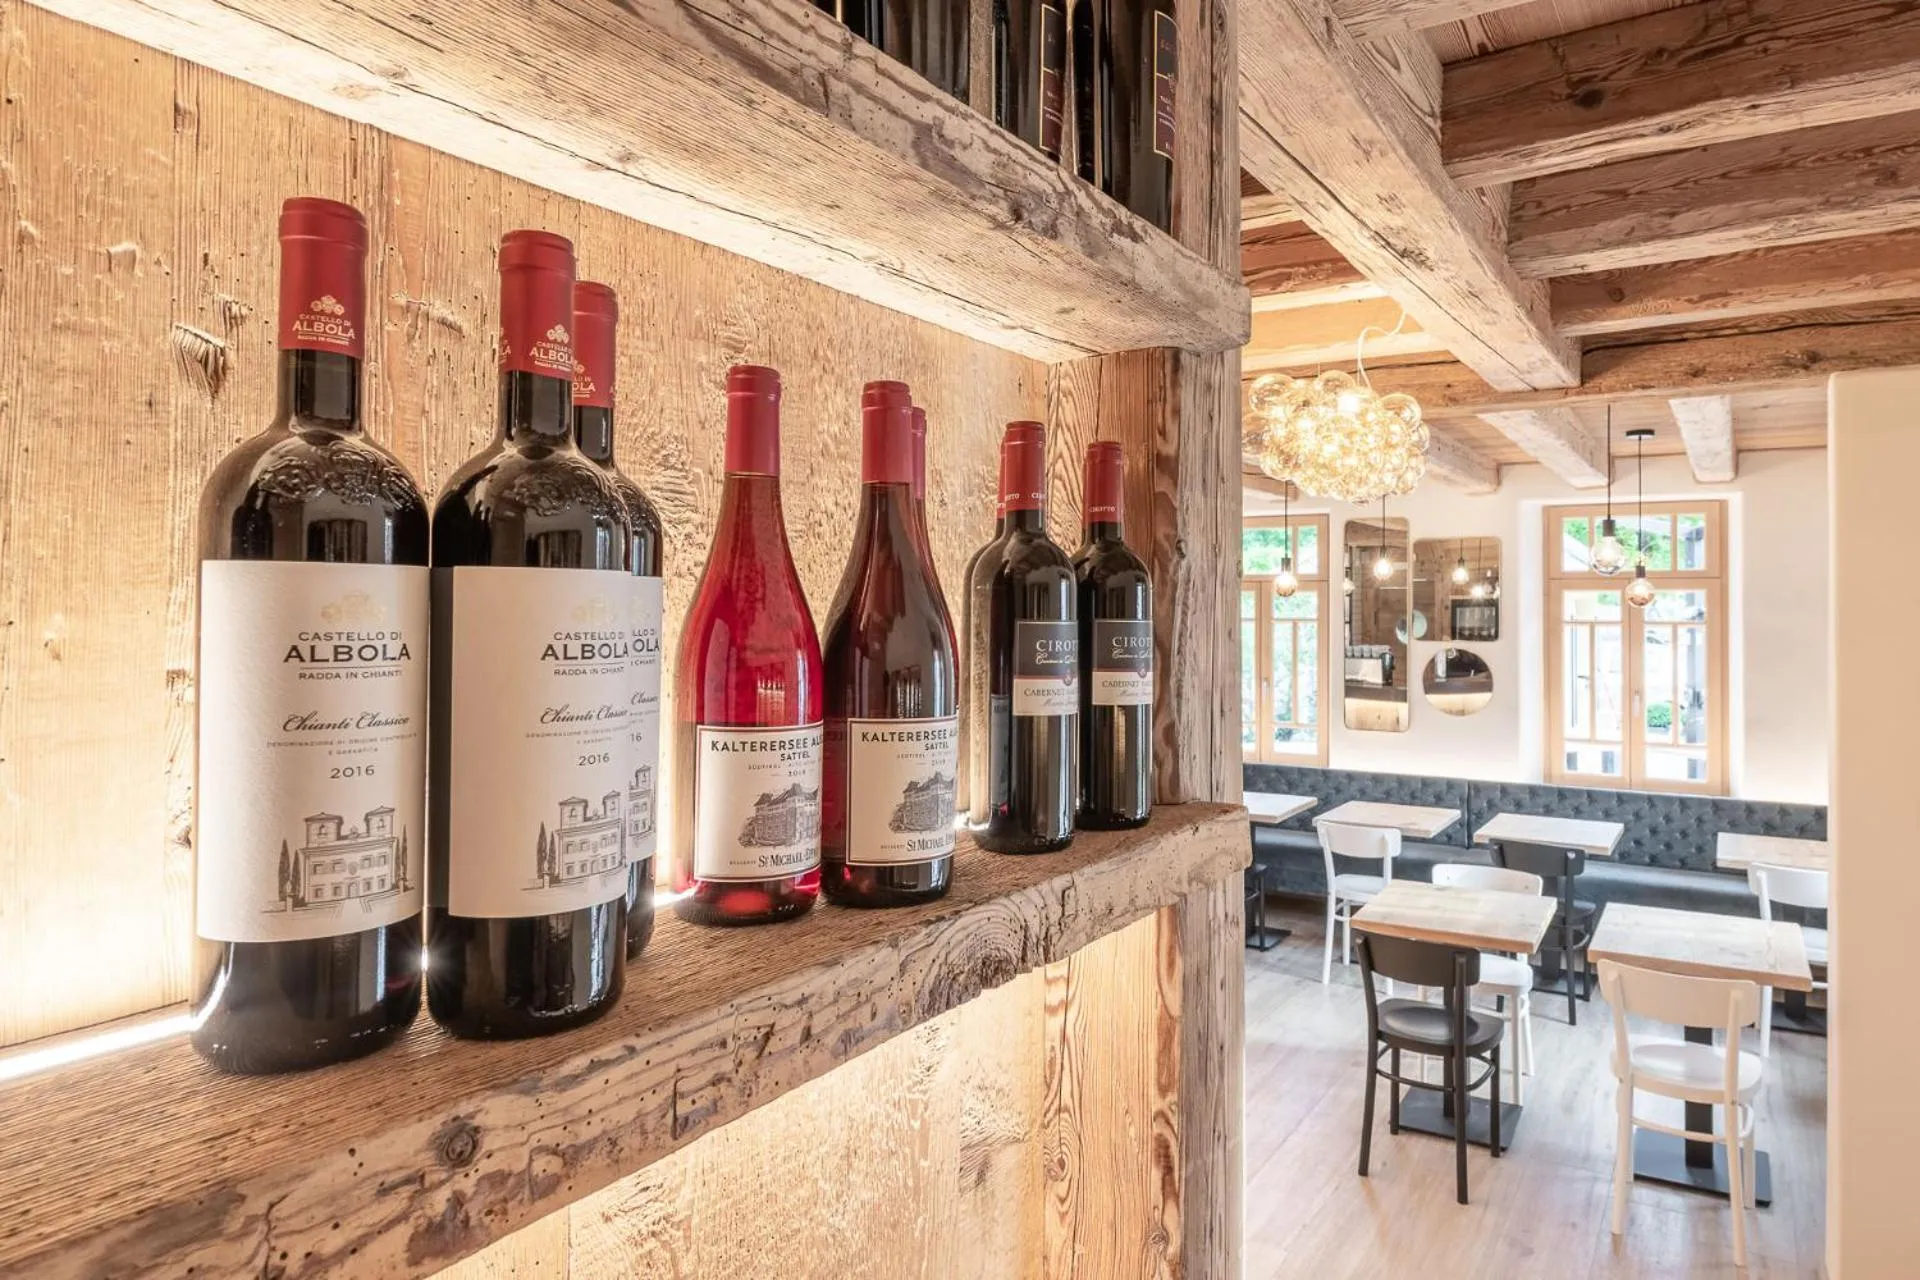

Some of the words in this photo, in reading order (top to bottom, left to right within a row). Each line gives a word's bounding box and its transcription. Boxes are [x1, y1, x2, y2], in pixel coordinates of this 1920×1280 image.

[292, 320, 355, 339] ALBOLA
[298, 631, 386, 642] CASTELLO
[390, 631, 402, 641] DI
[553, 631, 616, 641] CASTELLO
[283, 643, 411, 663] ALBOLA
[540, 643, 629, 661] ALBOLA
[298, 672, 342, 681] RADDA
[345, 671, 358, 680] IN
[282, 710, 353, 732] Chianti
[540, 704, 593, 725] Chianti
[861, 729, 948, 742] KALTERERSEE
[711, 738, 809, 752] KALTERERSEE
[578, 753, 610, 766] 2016
[780, 751, 810, 762] SATTEL
[328, 764, 375, 779] 2016
